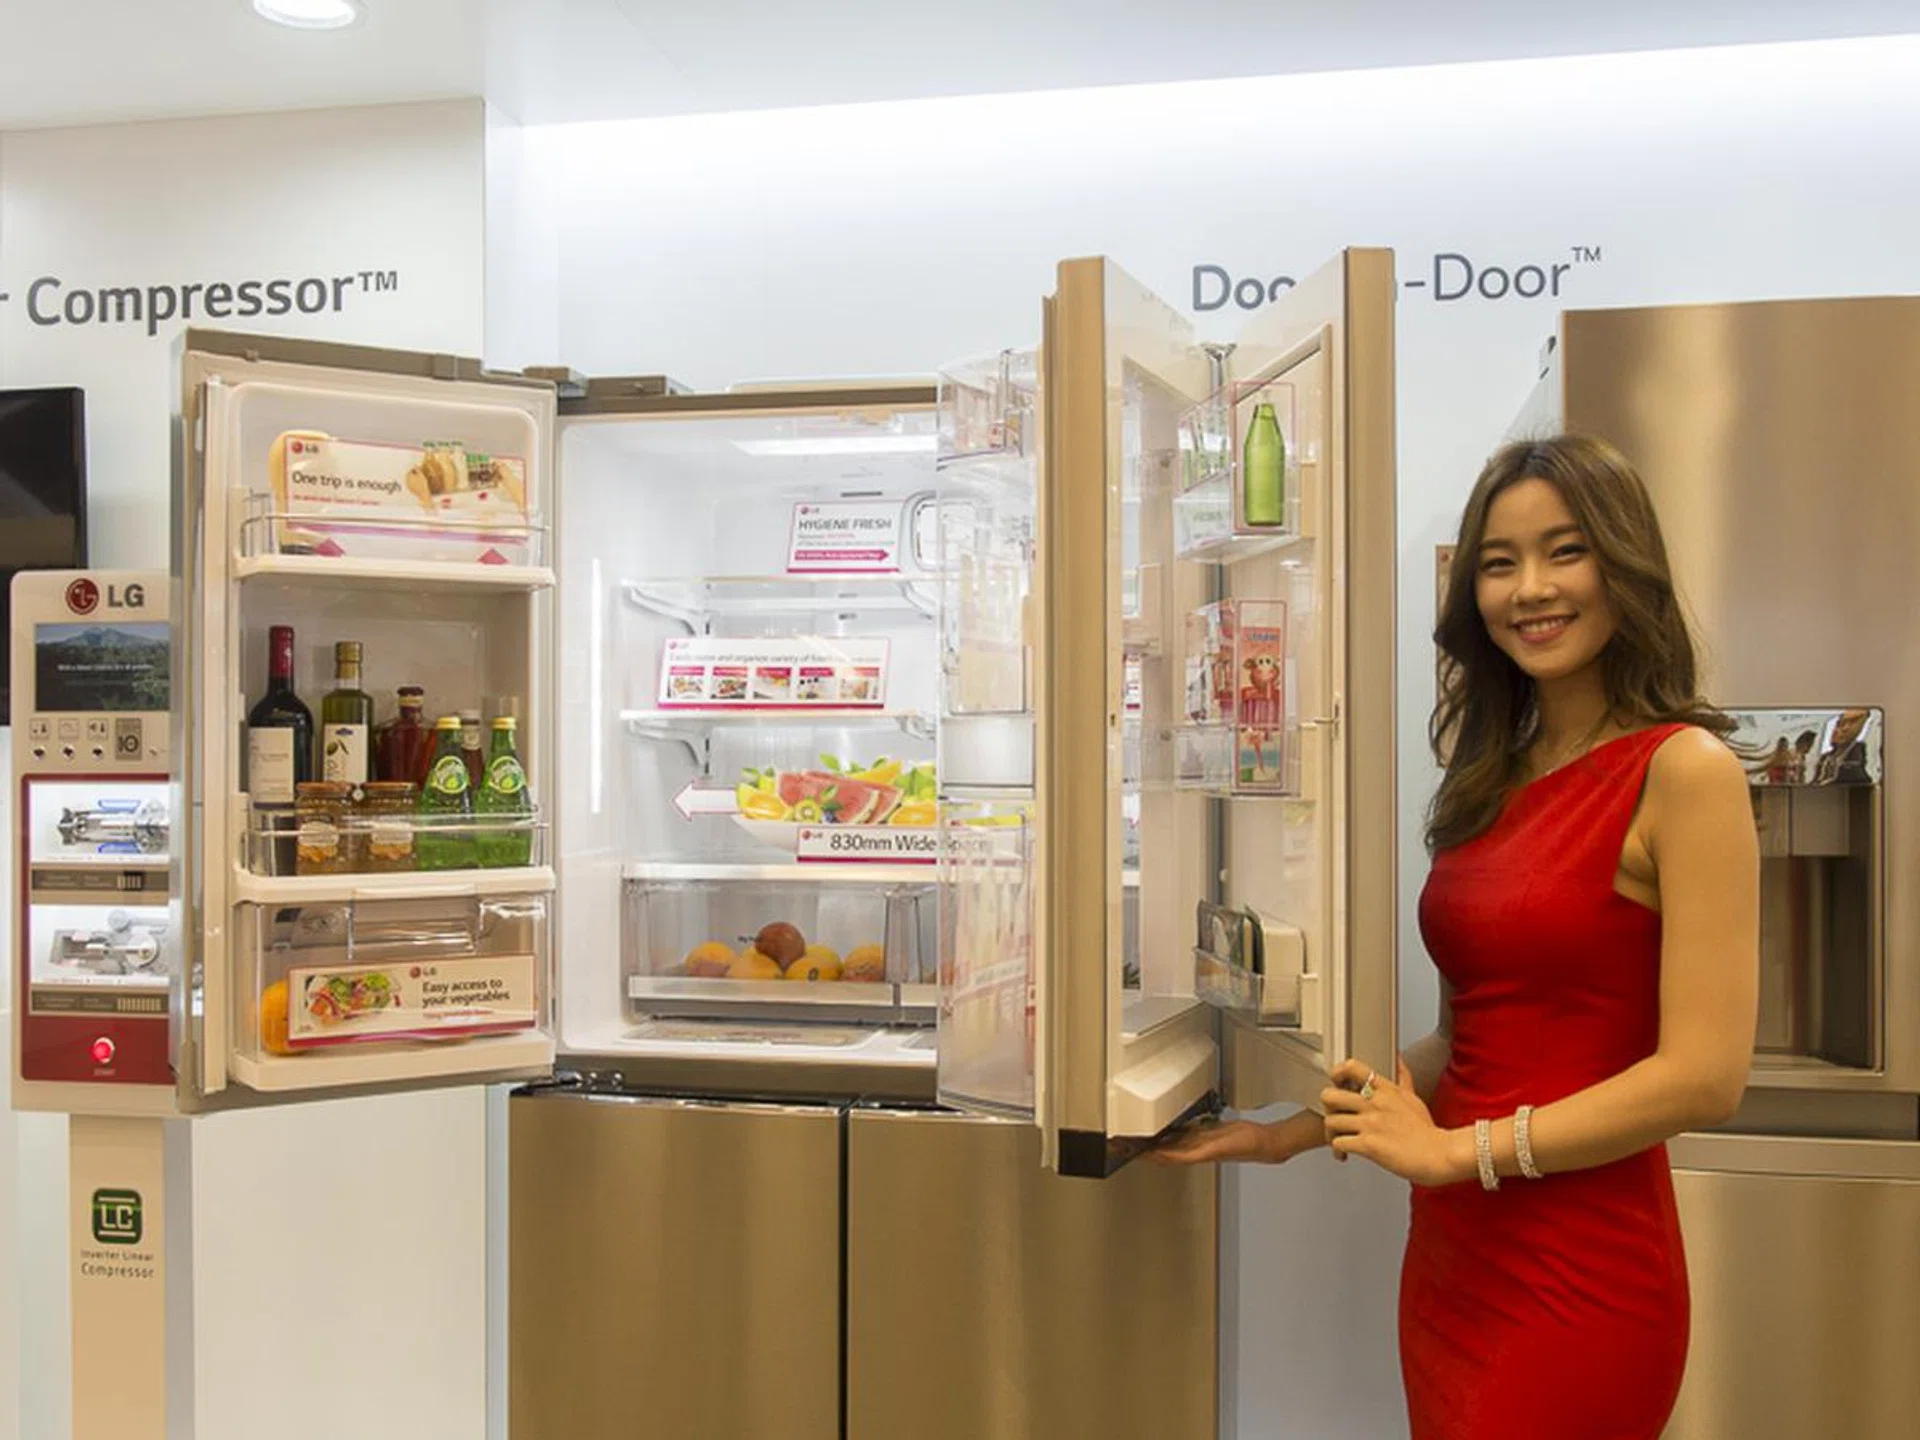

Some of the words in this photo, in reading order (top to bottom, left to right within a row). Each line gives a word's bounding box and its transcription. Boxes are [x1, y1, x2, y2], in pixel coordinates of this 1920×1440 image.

[293, 471, 319, 487] One
[321, 474, 343, 492] trip
[345, 478, 355, 489] is
[358, 479, 402, 498] enough
[798, 518, 850, 530] HYGIENE
[852, 517, 893, 529] FRESH
[107, 584, 145, 608] LG
[830, 835, 892, 851] 830mm
[895, 834, 937, 851] Wide
[422, 981, 449, 994] Easy
[452, 980, 488, 991] access
[490, 979, 503, 988] to
[422, 996, 447, 1009] your
[451, 991, 510, 1005] vegetables
